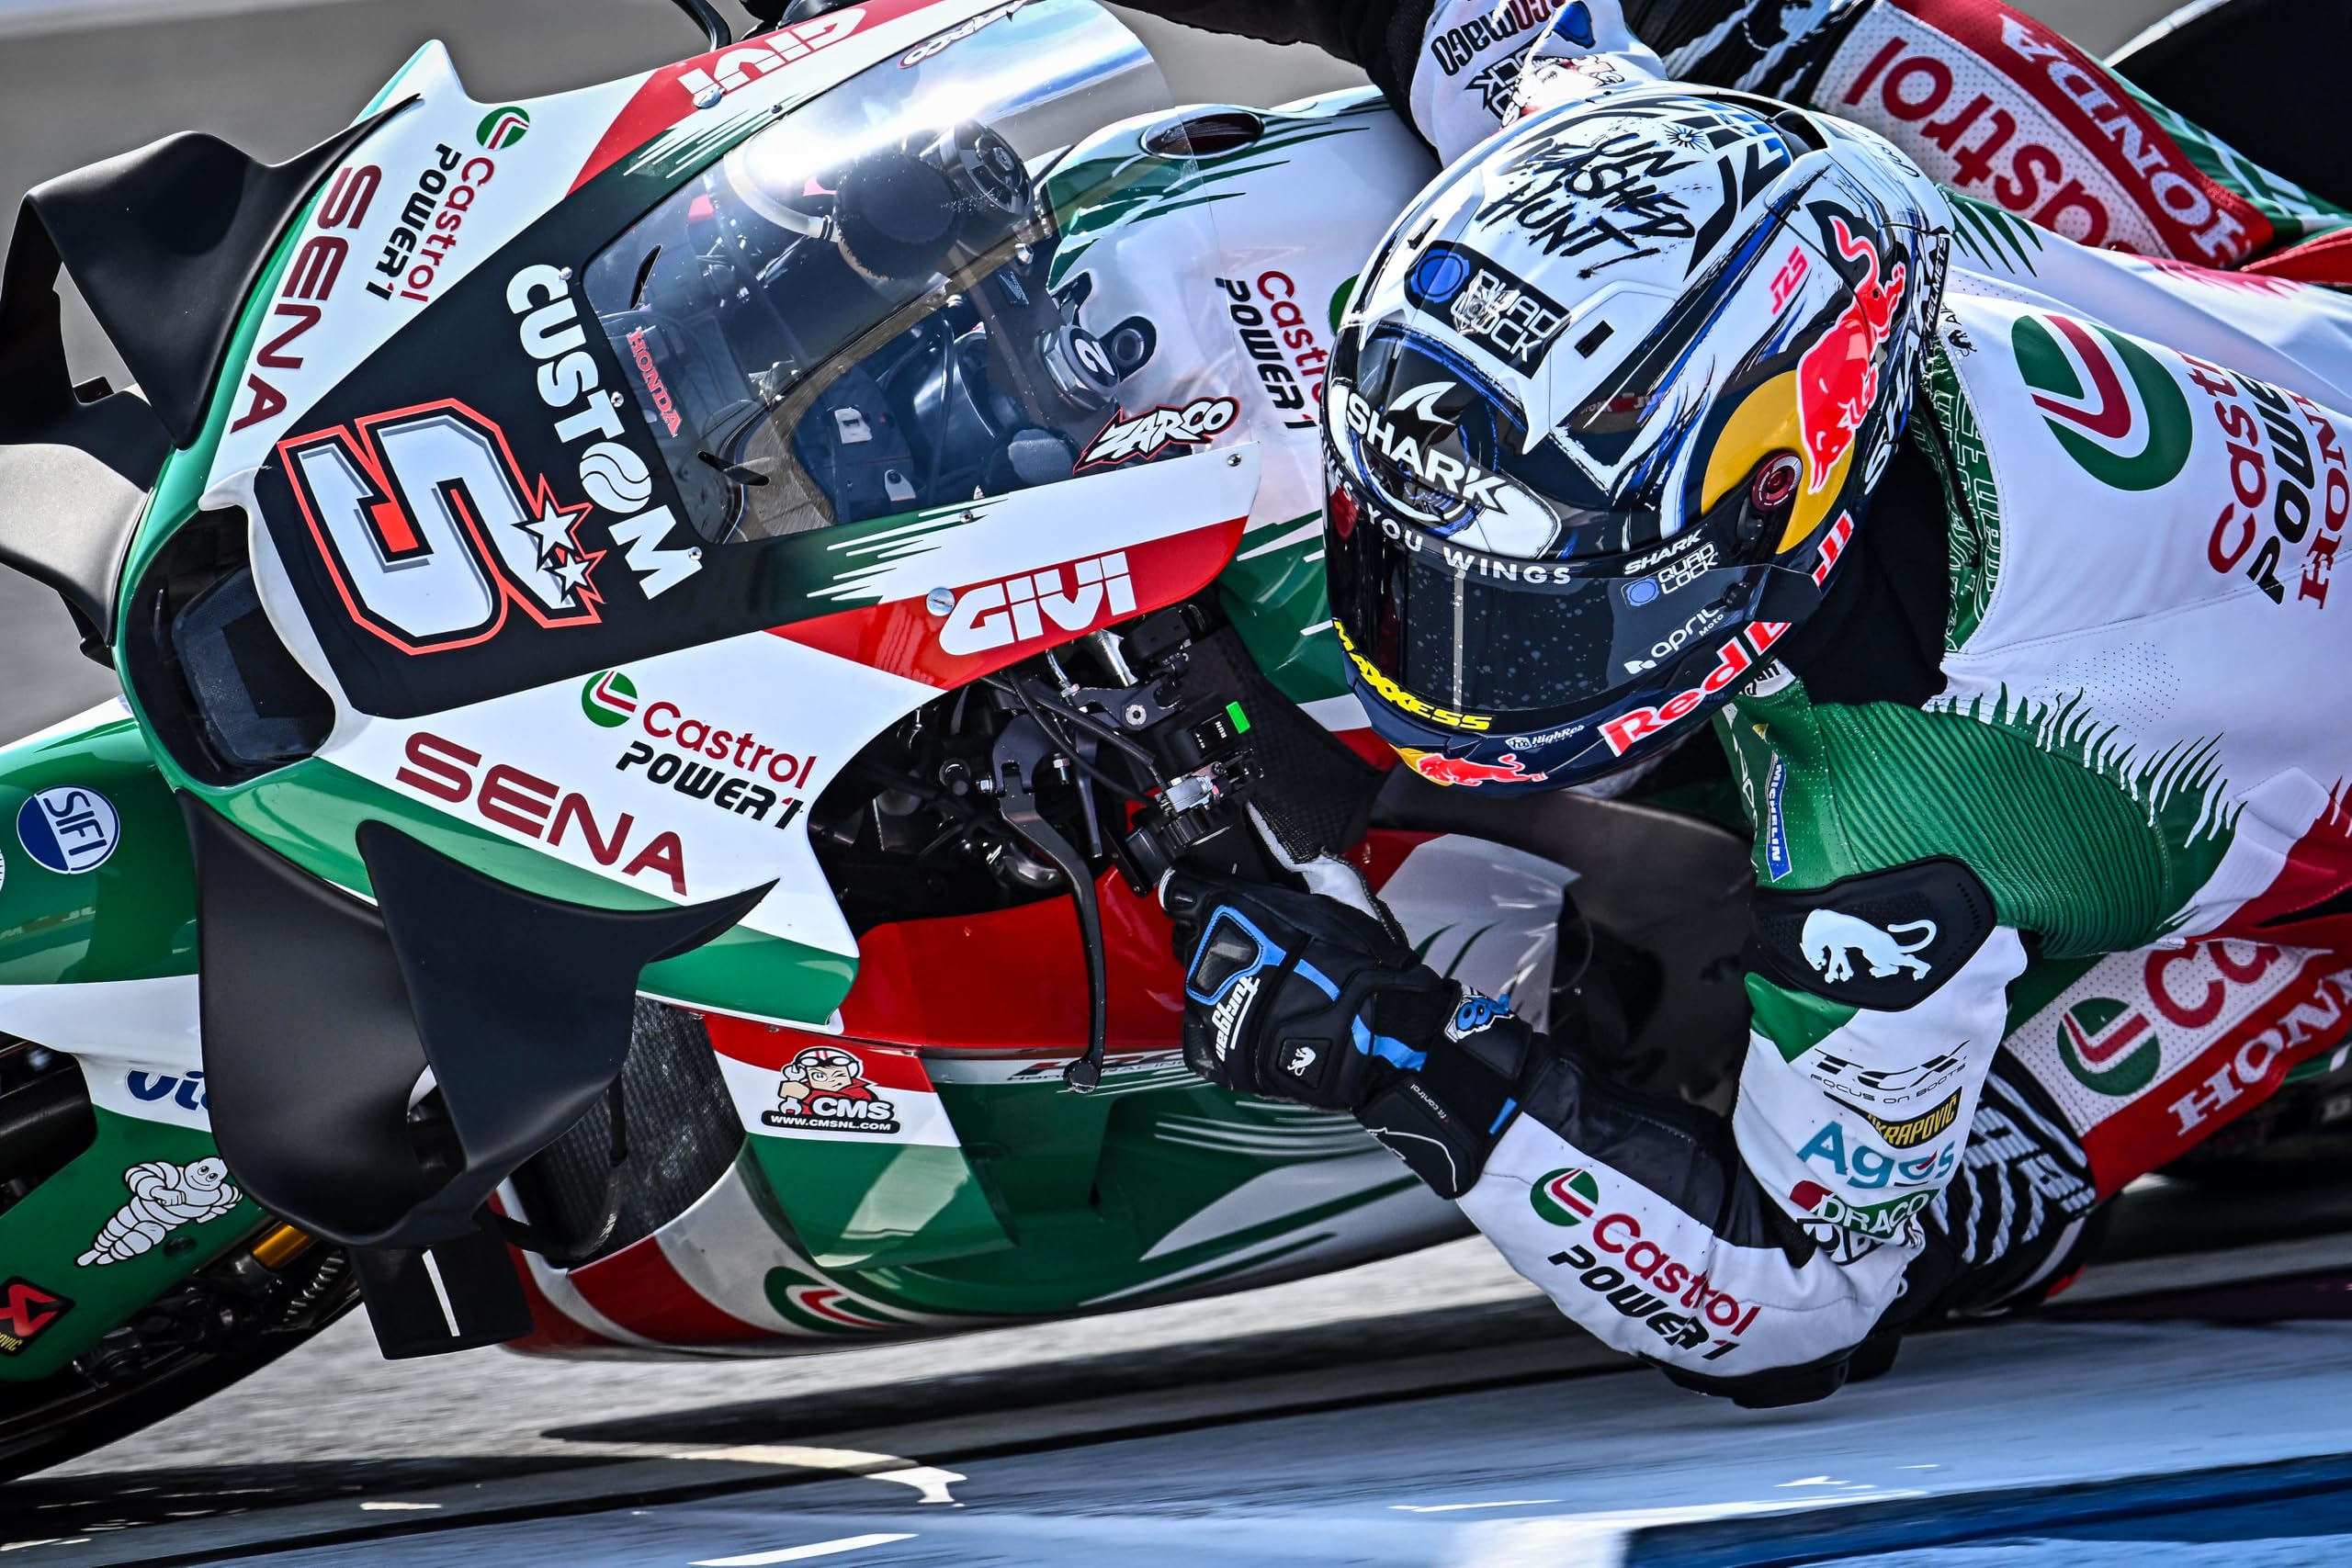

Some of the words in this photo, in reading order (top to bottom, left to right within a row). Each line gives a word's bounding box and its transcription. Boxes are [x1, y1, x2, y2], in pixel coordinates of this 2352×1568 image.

[678, 8, 866, 96] GIVI
[1843, 36, 2137, 253] astrol
[1996, 13, 2251, 268] HONDA
[401, 158, 494, 302] Castrol
[230, 164, 382, 434] SENA
[1926, 235, 1948, 333] HELMETS
[626, 327, 682, 437] HONDA
[506, 264, 702, 599] CUSTOM
[1084, 400, 1235, 462] ZARCO
[1346, 392, 1507, 514] SHARK
[278, 399, 603, 654] 5
[1366, 501, 1424, 552] YOU
[1442, 547, 1571, 586] WINGS
[1623, 528, 1702, 576] SHARK
[1657, 543, 1715, 582] QUAD
[939, 551, 1137, 656] GIVI
[1660, 554, 1718, 595] LOCK
[1699, 614, 1724, 637] Moto
[1333, 620, 1493, 731] MAXXESS
[1598, 636, 1753, 758] Red
[643, 702, 817, 790] Castrol
[1532, 724, 1585, 744] HighRes
[42, 790, 107, 856] SIFI
[396, 731, 687, 897] SENA
[616, 742, 805, 830] POWER1
[1769, 763, 1783, 862] MICHELIN
[771, 1114, 892, 1132] WWW.CMSNL.COM
[812, 1097, 891, 1121] CMS
[1410, 1084, 1439, 1111] control
[1810, 1073, 1875, 1101] FOCUS
[1917, 1063, 1966, 1098] BOOTS
[1796, 1121, 1955, 1189] Agos
[1814, 1193, 1929, 1235] DRACO
[1593, 1213, 1760, 1337] Castrol
